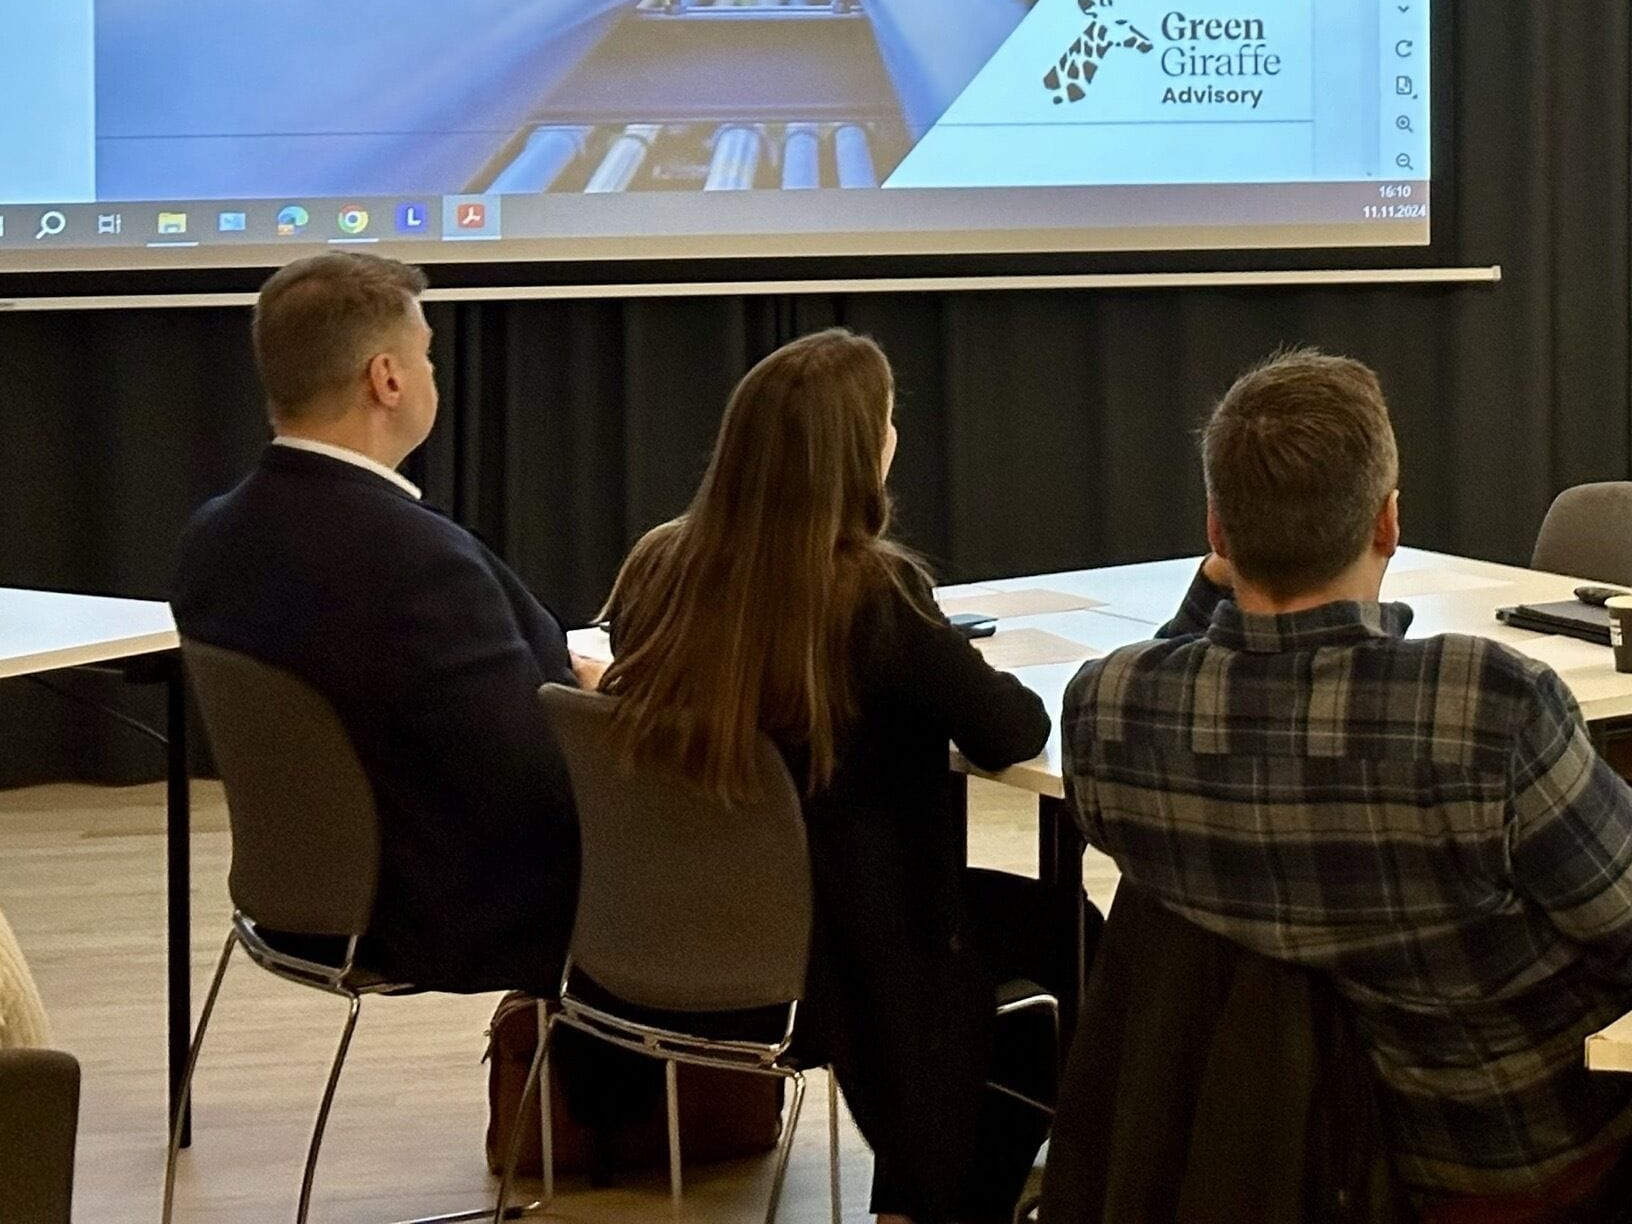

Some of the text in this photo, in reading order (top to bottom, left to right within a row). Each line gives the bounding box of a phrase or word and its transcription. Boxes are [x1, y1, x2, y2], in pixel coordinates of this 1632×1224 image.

[1160, 11, 1265, 42] Green
[1160, 43, 1281, 77] Giraffe
[1161, 85, 1263, 108] Advisory
[1379, 185, 1411, 198] 16:10
